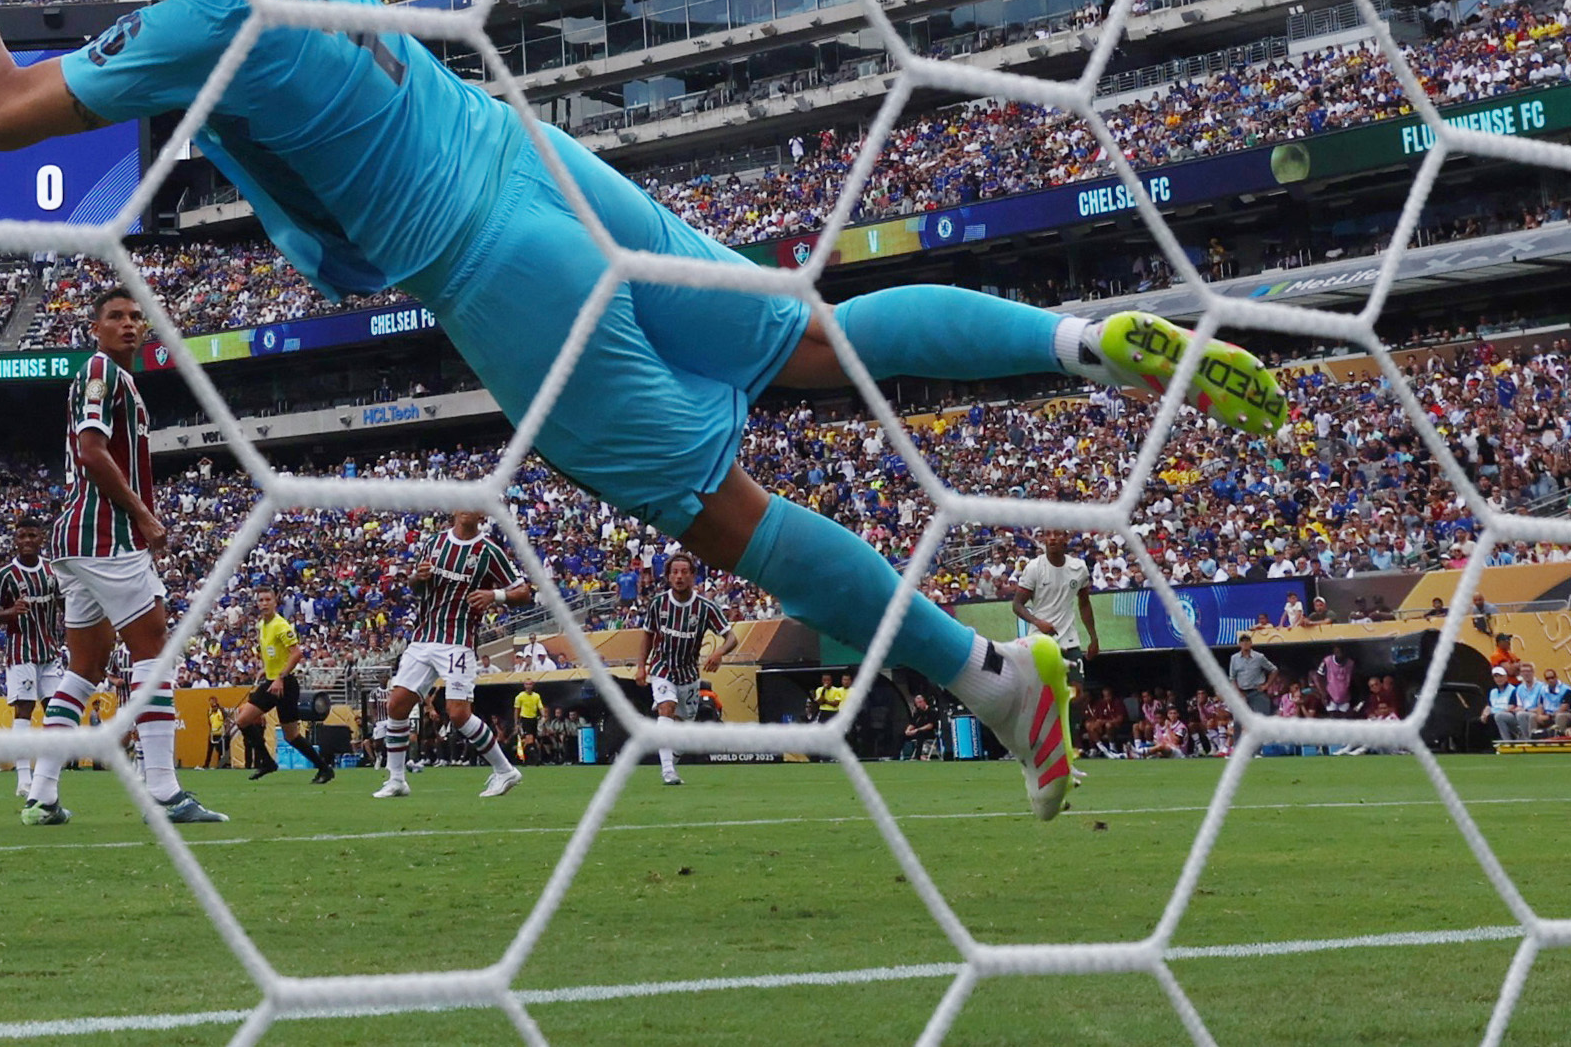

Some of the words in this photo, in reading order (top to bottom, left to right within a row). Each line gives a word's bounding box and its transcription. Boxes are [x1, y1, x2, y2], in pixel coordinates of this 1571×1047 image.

[1401, 106, 1516, 154] FLUINENSE
[1520, 101, 1538, 130] FC
[36, 164, 64, 210] 0
[1076, 183, 1141, 216] CHELSE
[1149, 177, 1169, 203] FC
[868, 230, 877, 253] V
[1285, 268, 1381, 293] MetLife
[370, 310, 418, 336] CHELSEA
[421, 308, 435, 328] FC
[211, 339, 218, 357] V
[49, 358, 67, 377] FC
[1125, 317, 1284, 417] PREDTOR
[363, 404, 419, 425] HCLTech
[448, 652, 467, 674] 14
[709, 753, 736, 762] WORLD
[738, 753, 754, 762] CUP
[755, 753, 774, 762] 2025
